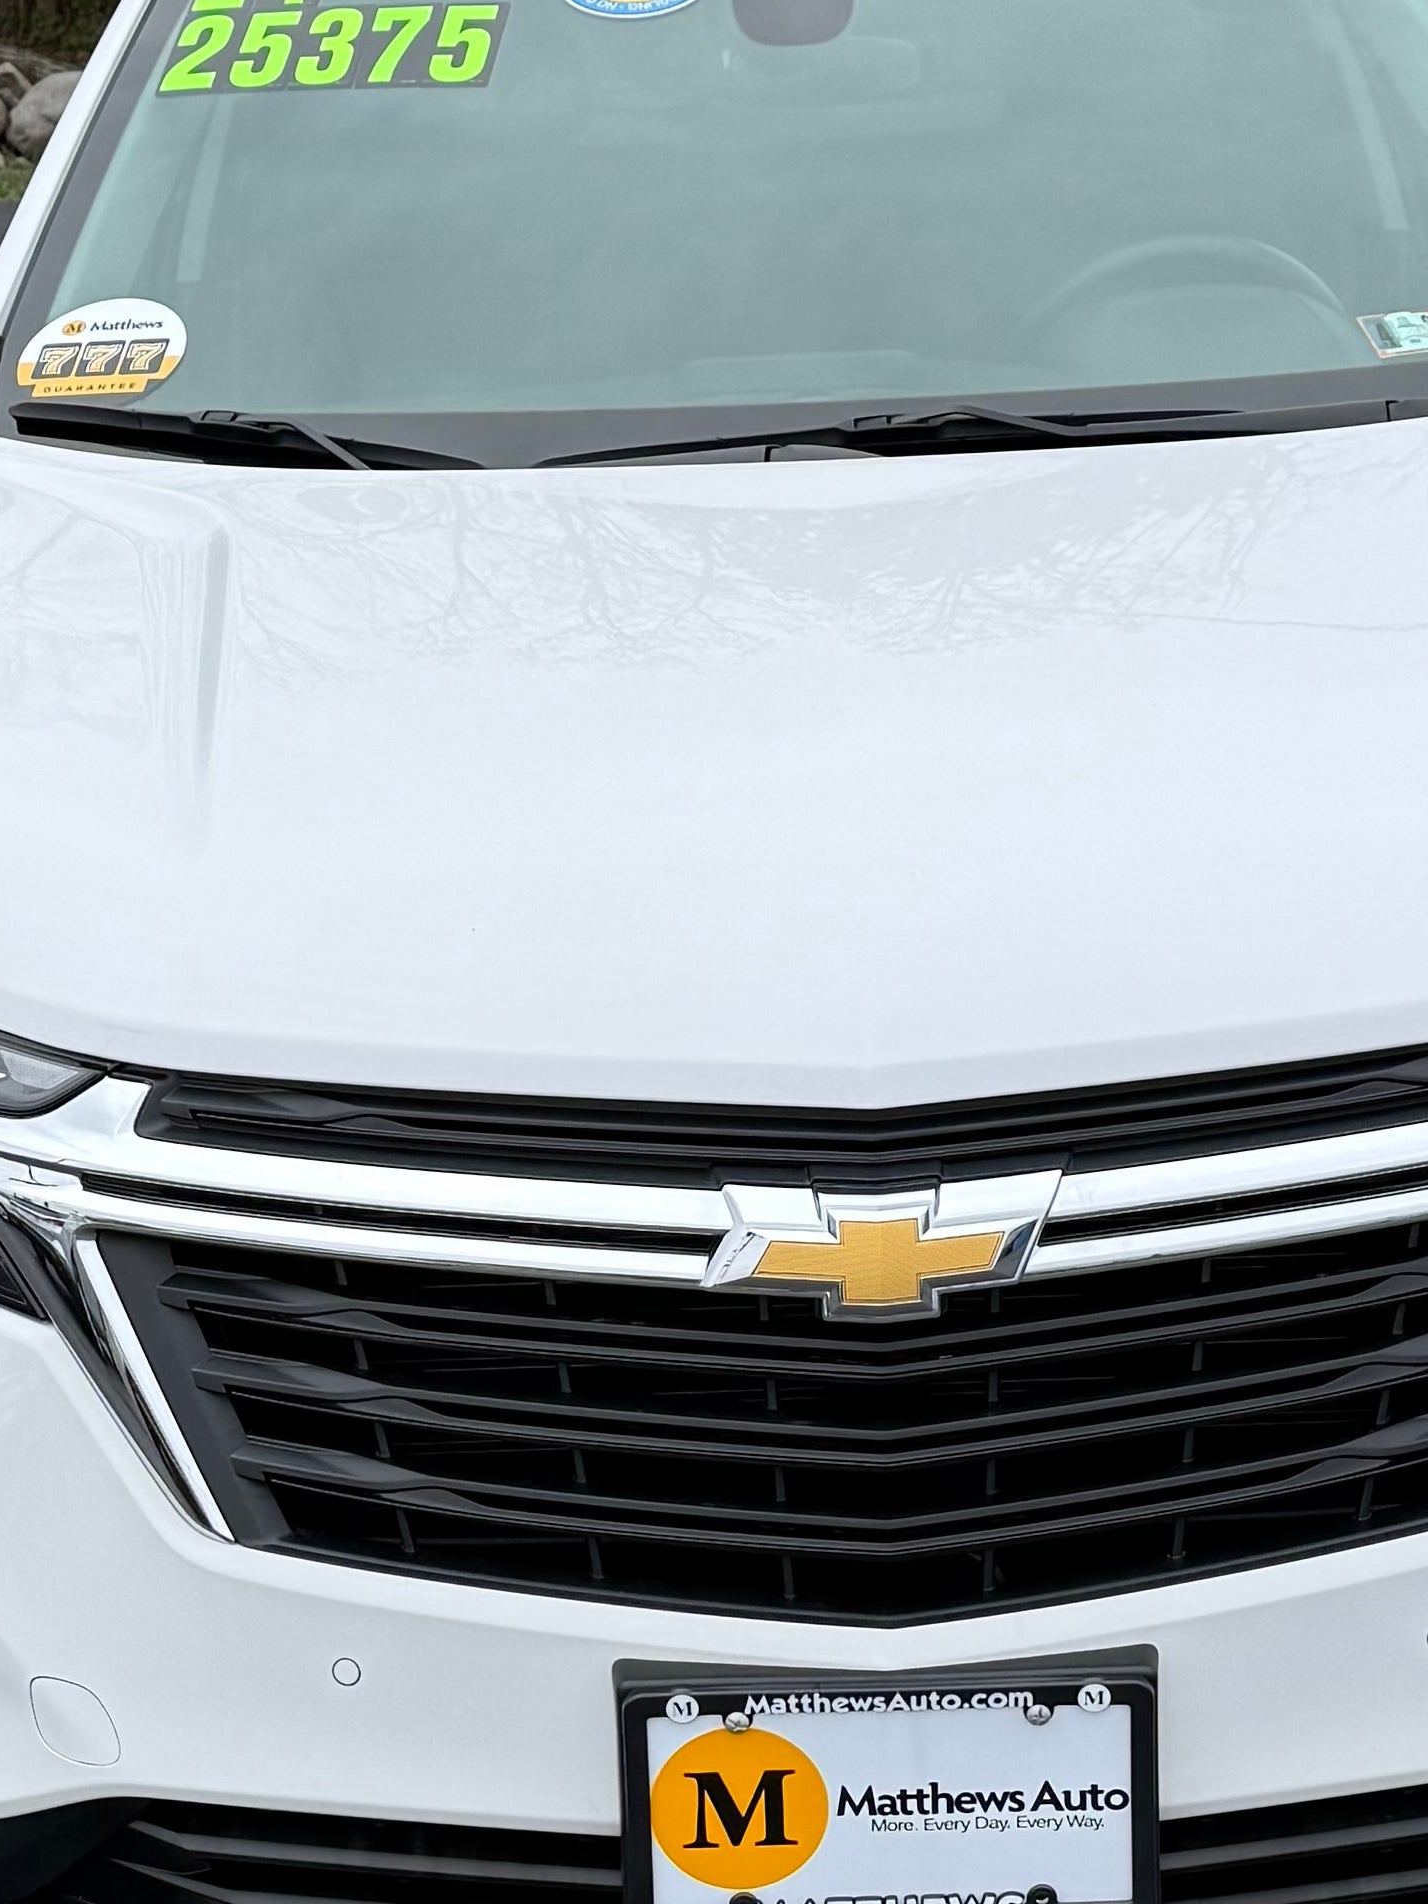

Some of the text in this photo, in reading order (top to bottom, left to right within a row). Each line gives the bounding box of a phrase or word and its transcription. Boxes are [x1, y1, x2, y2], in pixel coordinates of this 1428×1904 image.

[158, 4, 500, 93] 25375
[90, 319, 163, 332] Matthews
[672, 1690, 1105, 1717] M MatthewsAuto.com M
[683, 1768, 796, 1849] M
[836, 1779, 1130, 1817] Matthews Auto
[871, 1813, 1105, 1834] More. Every Day. Every Way.
